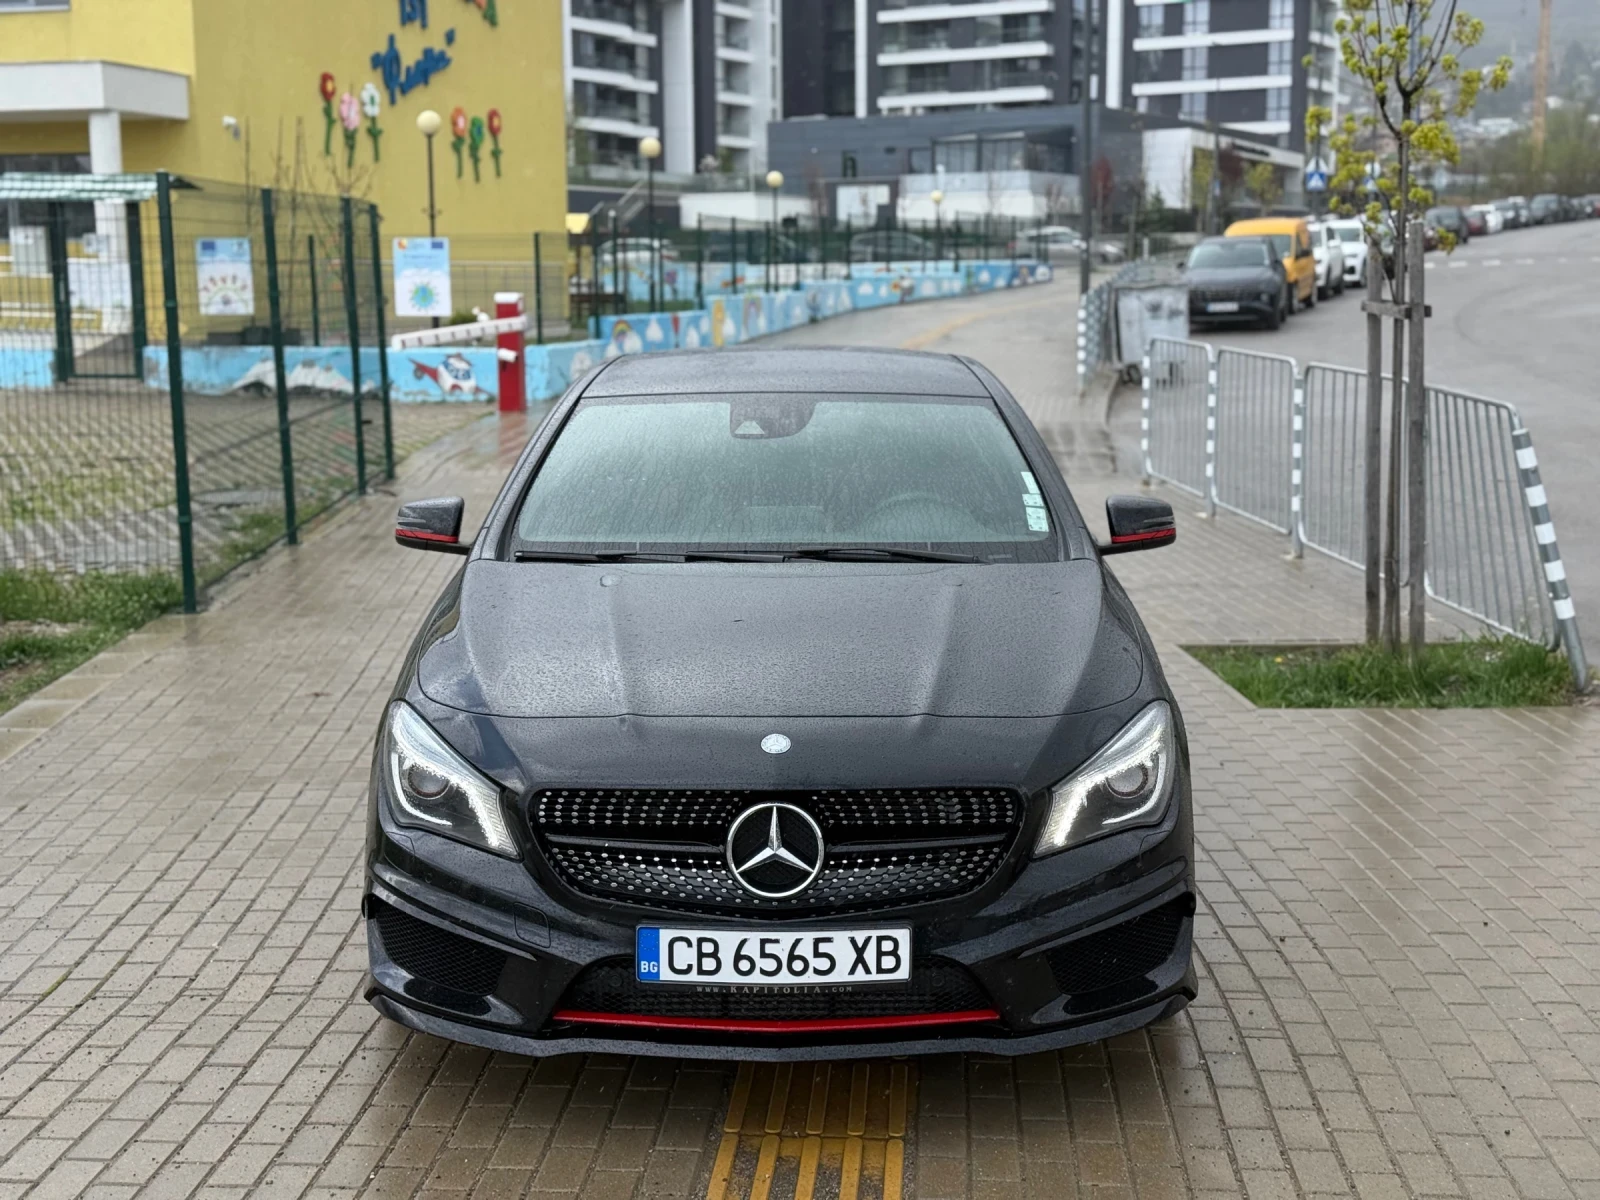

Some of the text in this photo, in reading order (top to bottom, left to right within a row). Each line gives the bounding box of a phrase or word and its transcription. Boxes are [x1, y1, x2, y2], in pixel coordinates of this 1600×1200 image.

[640, 962, 659, 973] BG
[667, 935, 902, 977] CB 6565 XB
